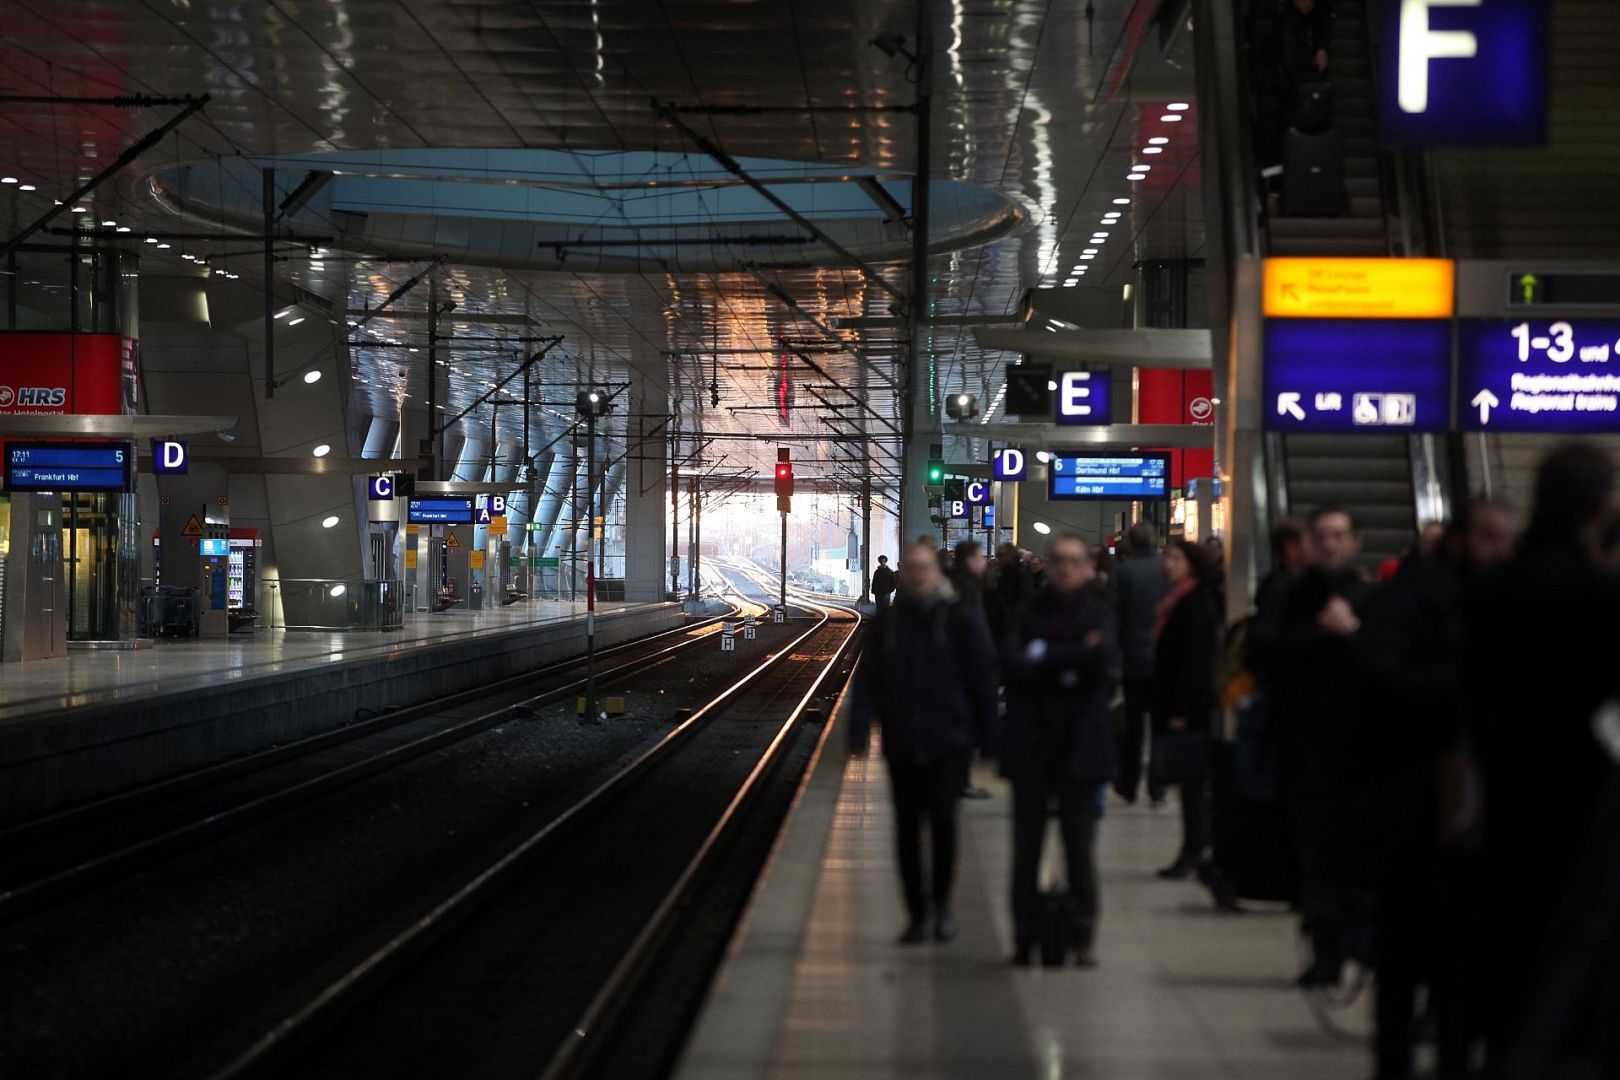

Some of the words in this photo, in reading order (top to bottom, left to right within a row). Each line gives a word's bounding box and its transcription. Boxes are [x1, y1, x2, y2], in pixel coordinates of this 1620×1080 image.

[1398, 0, 1483, 113] F
[1511, 321, 1575, 363] 1-3
[18, 387, 66, 406] HRS
[1061, 372, 1091, 415] E
[115, 450, 123, 462] 5
[163, 442, 184, 468] D
[1003, 449, 1024, 476] D
[1054, 458, 1063, 470] 6
[34, 473, 65, 481] Frankfurt
[67, 473, 79, 481] Hbf
[375, 477, 390, 496] C
[967, 482, 983, 502] C
[493, 496, 505, 511] B
[952, 501, 964, 516] B
[479, 508, 490, 521] A
[746, 629, 753, 638] H
[724, 638, 731, 649] H
